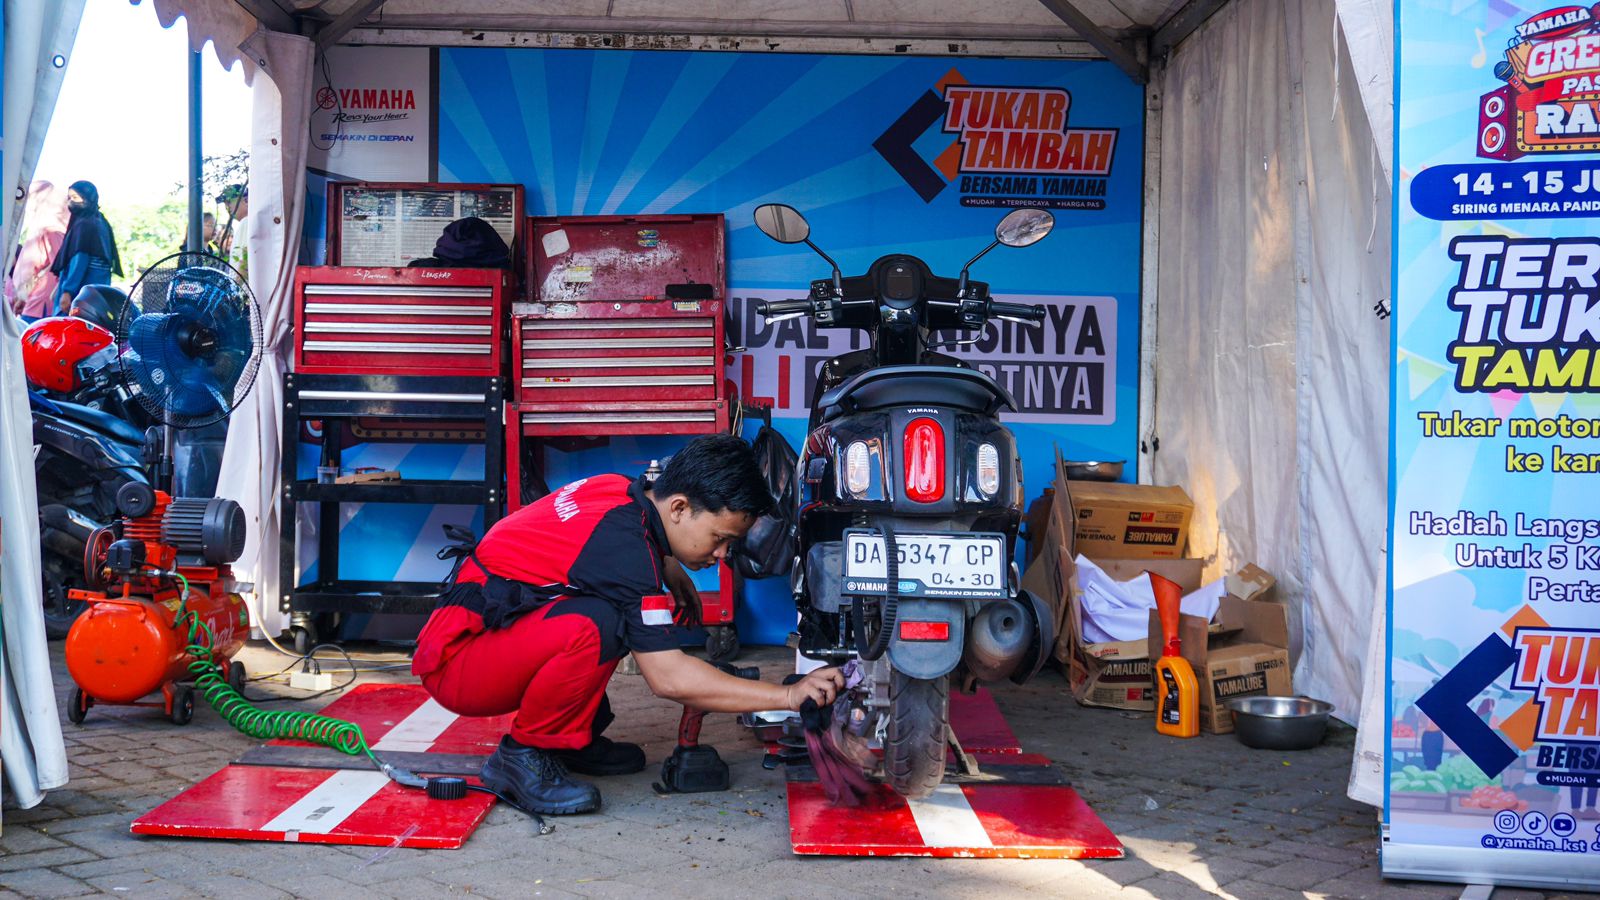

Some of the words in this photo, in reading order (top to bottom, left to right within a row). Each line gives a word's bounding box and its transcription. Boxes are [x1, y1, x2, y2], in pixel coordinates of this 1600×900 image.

[1515, 8, 1591, 37] YAMAHA
[1527, 35, 1600, 77] GRE
[340, 89, 416, 109] YAMAHA
[949, 91, 1066, 130] TUKAR
[332, 112, 361, 123] Revs
[363, 113, 384, 124] Your
[385, 112, 408, 121] Heart
[1535, 103, 1600, 134] RA
[965, 131, 1113, 171] TAMBAH
[960, 176, 1038, 194] BERSAMA
[1042, 179, 1107, 196] YAMAHA
[1452, 172, 1495, 196] 14
[1522, 171, 1564, 194] 15
[1452, 203, 1497, 214] SIRING
[1501, 202, 1560, 213] MENARA
[1454, 240, 1600, 289] TER
[1453, 290, 1600, 343] TUK
[1453, 346, 1600, 387] TAM
[1418, 410, 1502, 438] Tukar
[1505, 445, 1544, 473] ke
[1129, 532, 1173, 543] YAMALUBE
[1410, 511, 1507, 537] Hadiah
[1515, 512, 1600, 545] Langs
[855, 542, 881, 564] DA
[897, 543, 951, 565] 5347
[966, 545, 993, 566] CP
[1456, 543, 1542, 568] Untuk
[1548, 545, 1568, 569] 5
[857, 582, 887, 592] YAMAHA
[1104, 663, 1152, 676] AMALUBE
[1217, 675, 1265, 697] YAMALUBE
[1544, 687, 1600, 736] TA
[1551, 775, 1586, 785] MUDAH
[1482, 836, 1587, 853] @yamaha_kst
